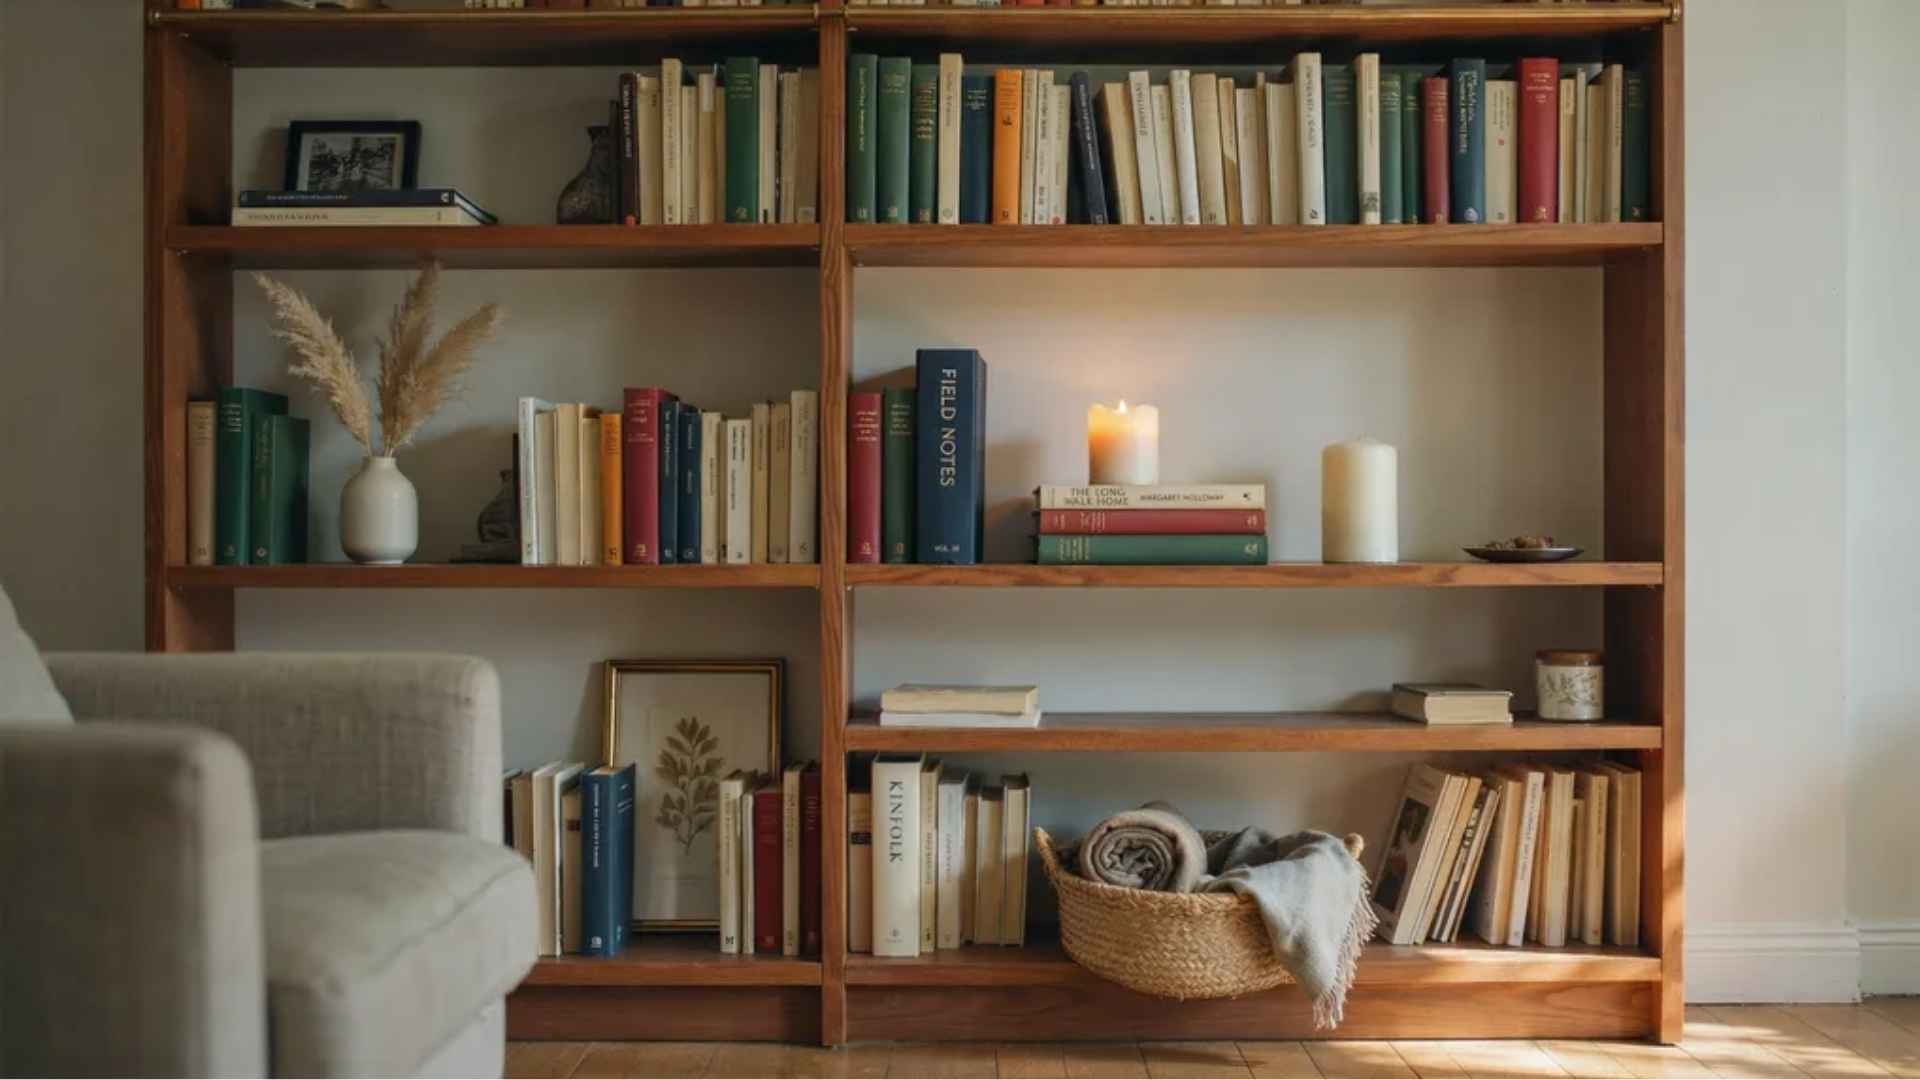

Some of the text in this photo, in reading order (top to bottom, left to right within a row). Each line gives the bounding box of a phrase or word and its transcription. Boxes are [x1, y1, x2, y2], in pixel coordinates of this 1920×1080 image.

[940, 369, 957, 486] FIELD NOTES
[1064, 497, 1128, 505] WALK HOME
[1072, 487, 1126, 496] THE LONG
[889, 781, 904, 862] KINFOLK
